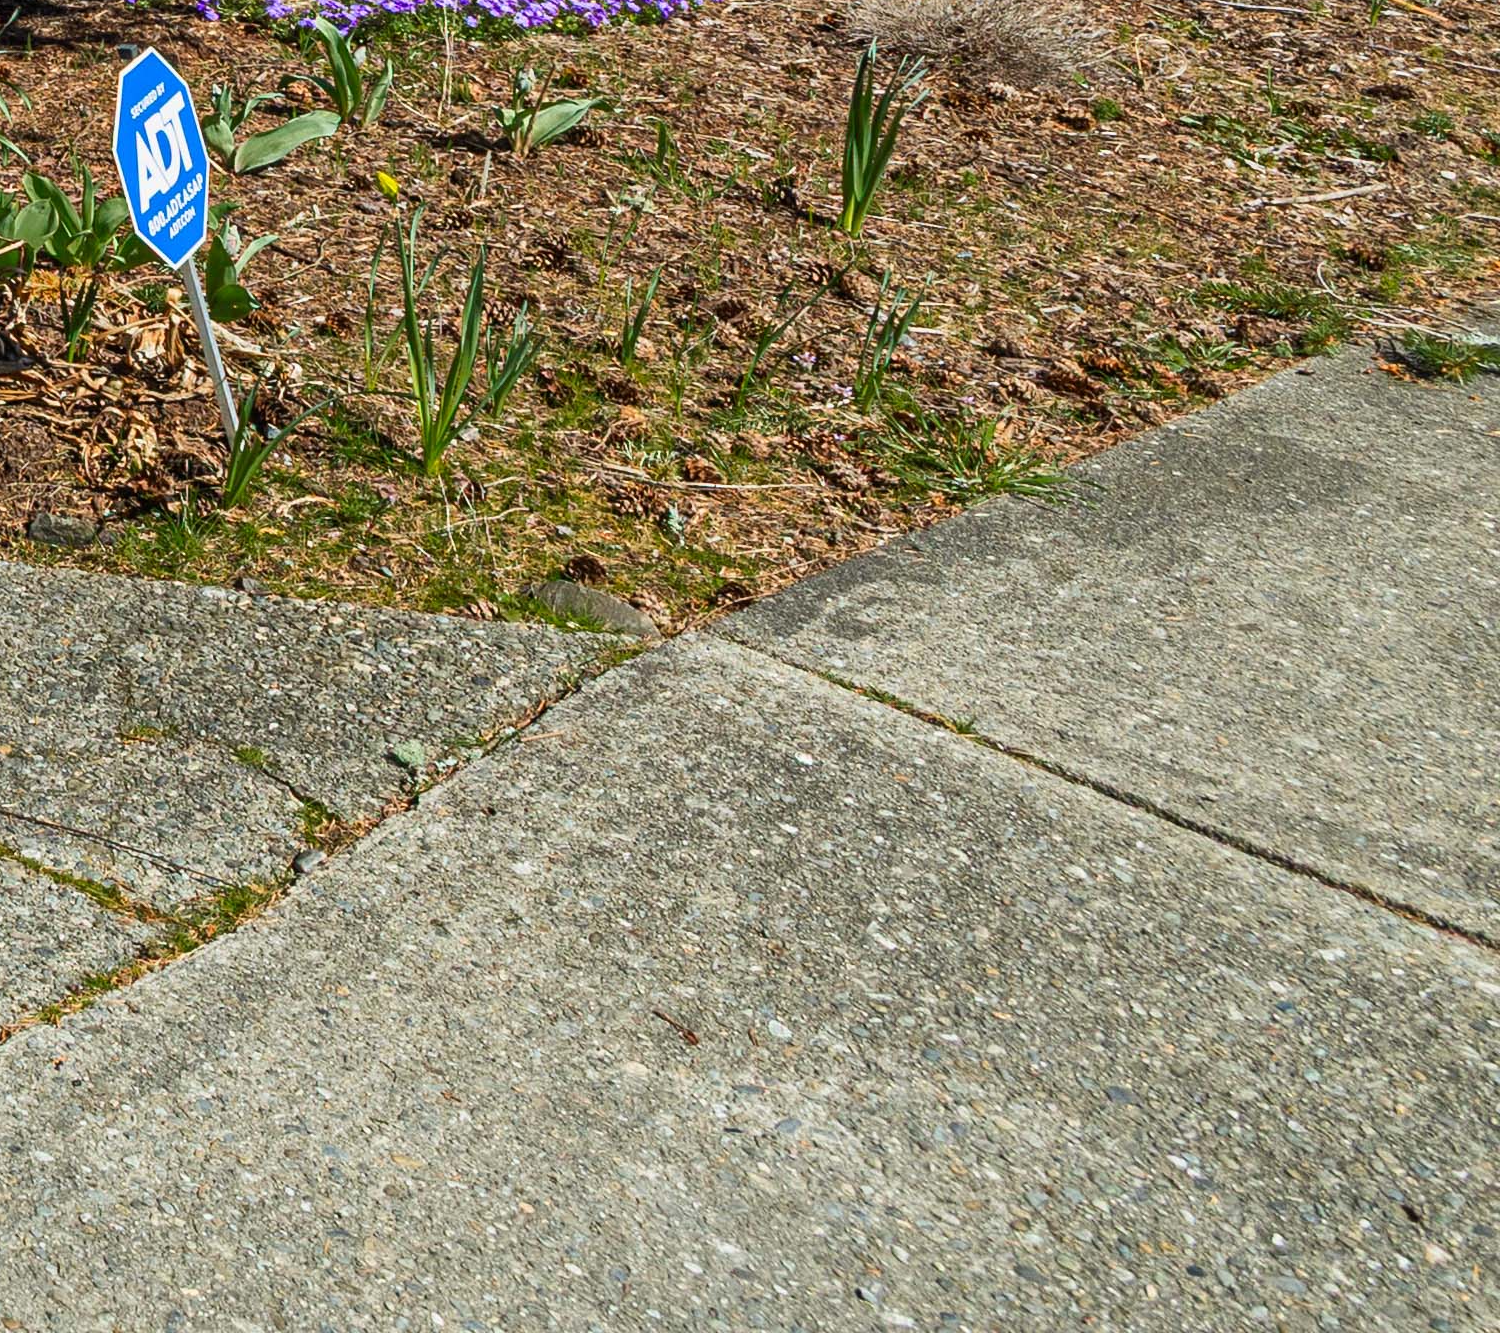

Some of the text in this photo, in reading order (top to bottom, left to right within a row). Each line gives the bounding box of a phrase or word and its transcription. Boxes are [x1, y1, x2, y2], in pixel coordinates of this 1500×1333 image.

[130, 81, 165, 119] SECURED BY
[135, 89, 193, 214] ADT
[147, 172, 204, 237] 800.ADT.ASAP
